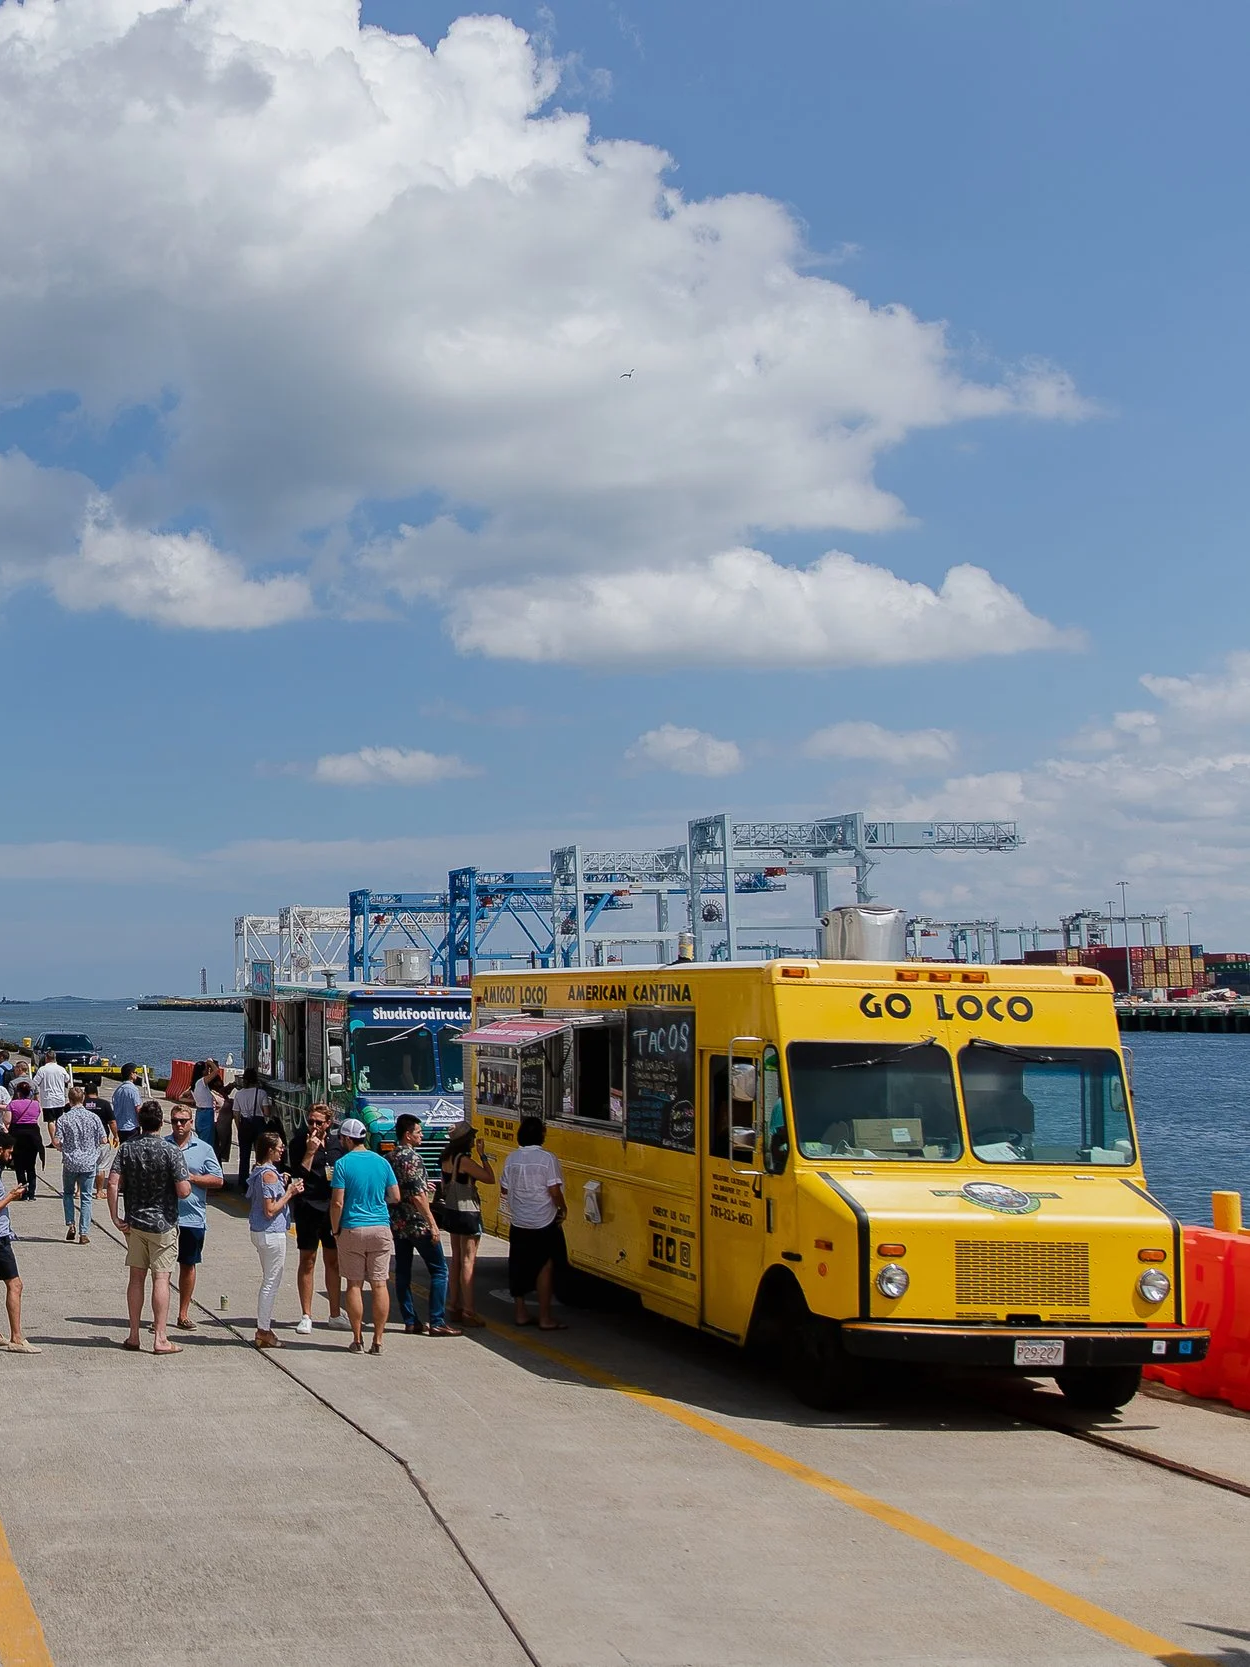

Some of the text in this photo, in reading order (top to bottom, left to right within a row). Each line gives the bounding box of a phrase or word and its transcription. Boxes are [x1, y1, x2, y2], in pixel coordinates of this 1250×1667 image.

[483, 984, 692, 1005] AMIGOS LOCOS AMERICAN CANTINA
[859, 992, 1034, 1023] GO LOCO
[373, 1006, 472, 1021] ShuckFoodTruck.
[633, 1022, 689, 1056] TACOS
